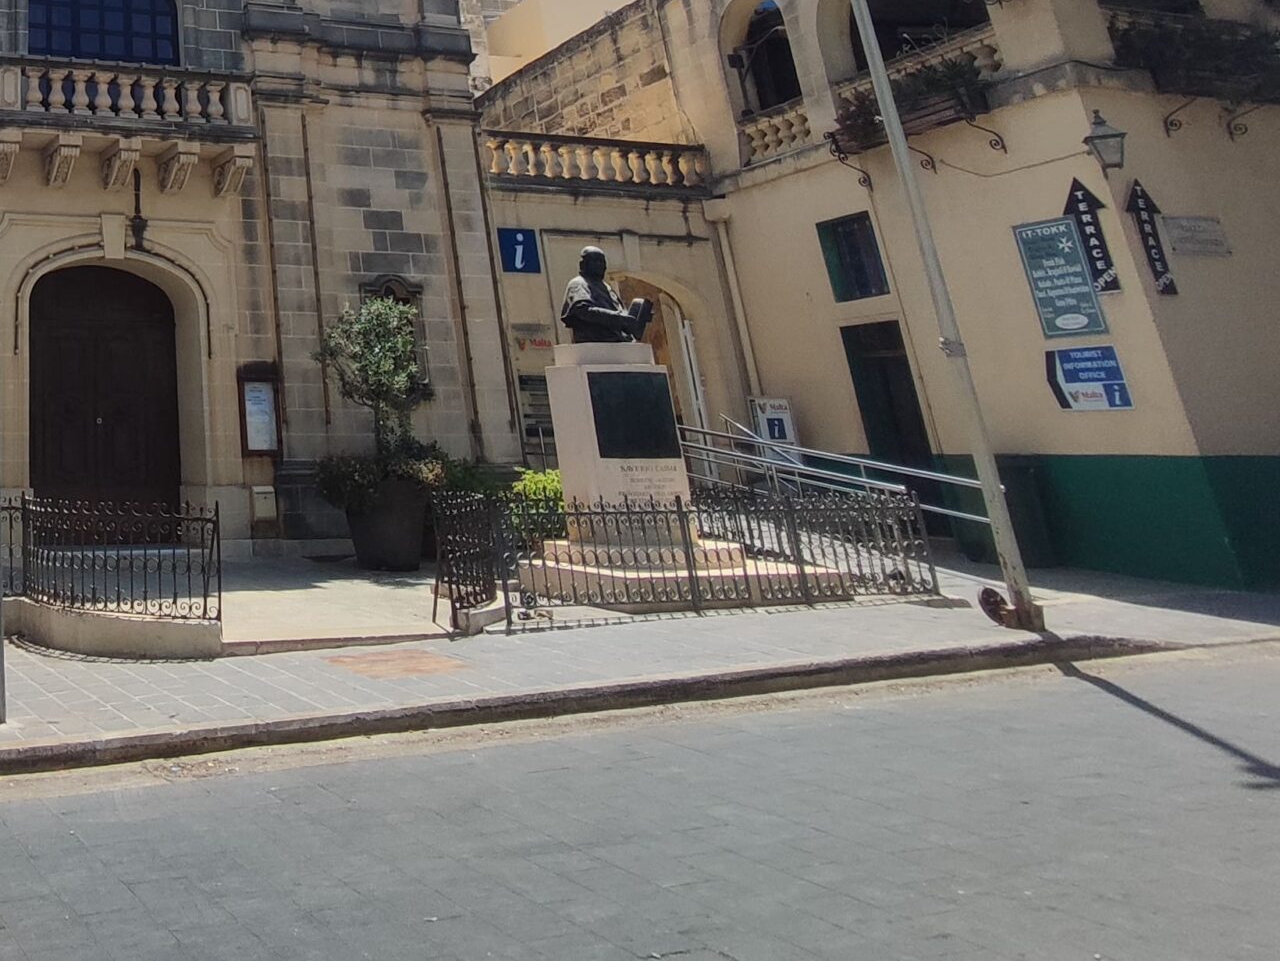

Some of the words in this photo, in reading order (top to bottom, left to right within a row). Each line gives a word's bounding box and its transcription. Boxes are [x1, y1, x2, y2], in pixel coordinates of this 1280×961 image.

[1021, 223, 1068, 239] IT-TOKK
[1073, 190, 1106, 270] TERRACE
[1134, 185, 1164, 272] TERRACE
[1093, 265, 1118, 292] OPEN
[1069, 350, 1103, 358] TOURIST
[1062, 359, 1117, 370] INFORMATION
[1078, 371, 1106, 379] OFFICE
